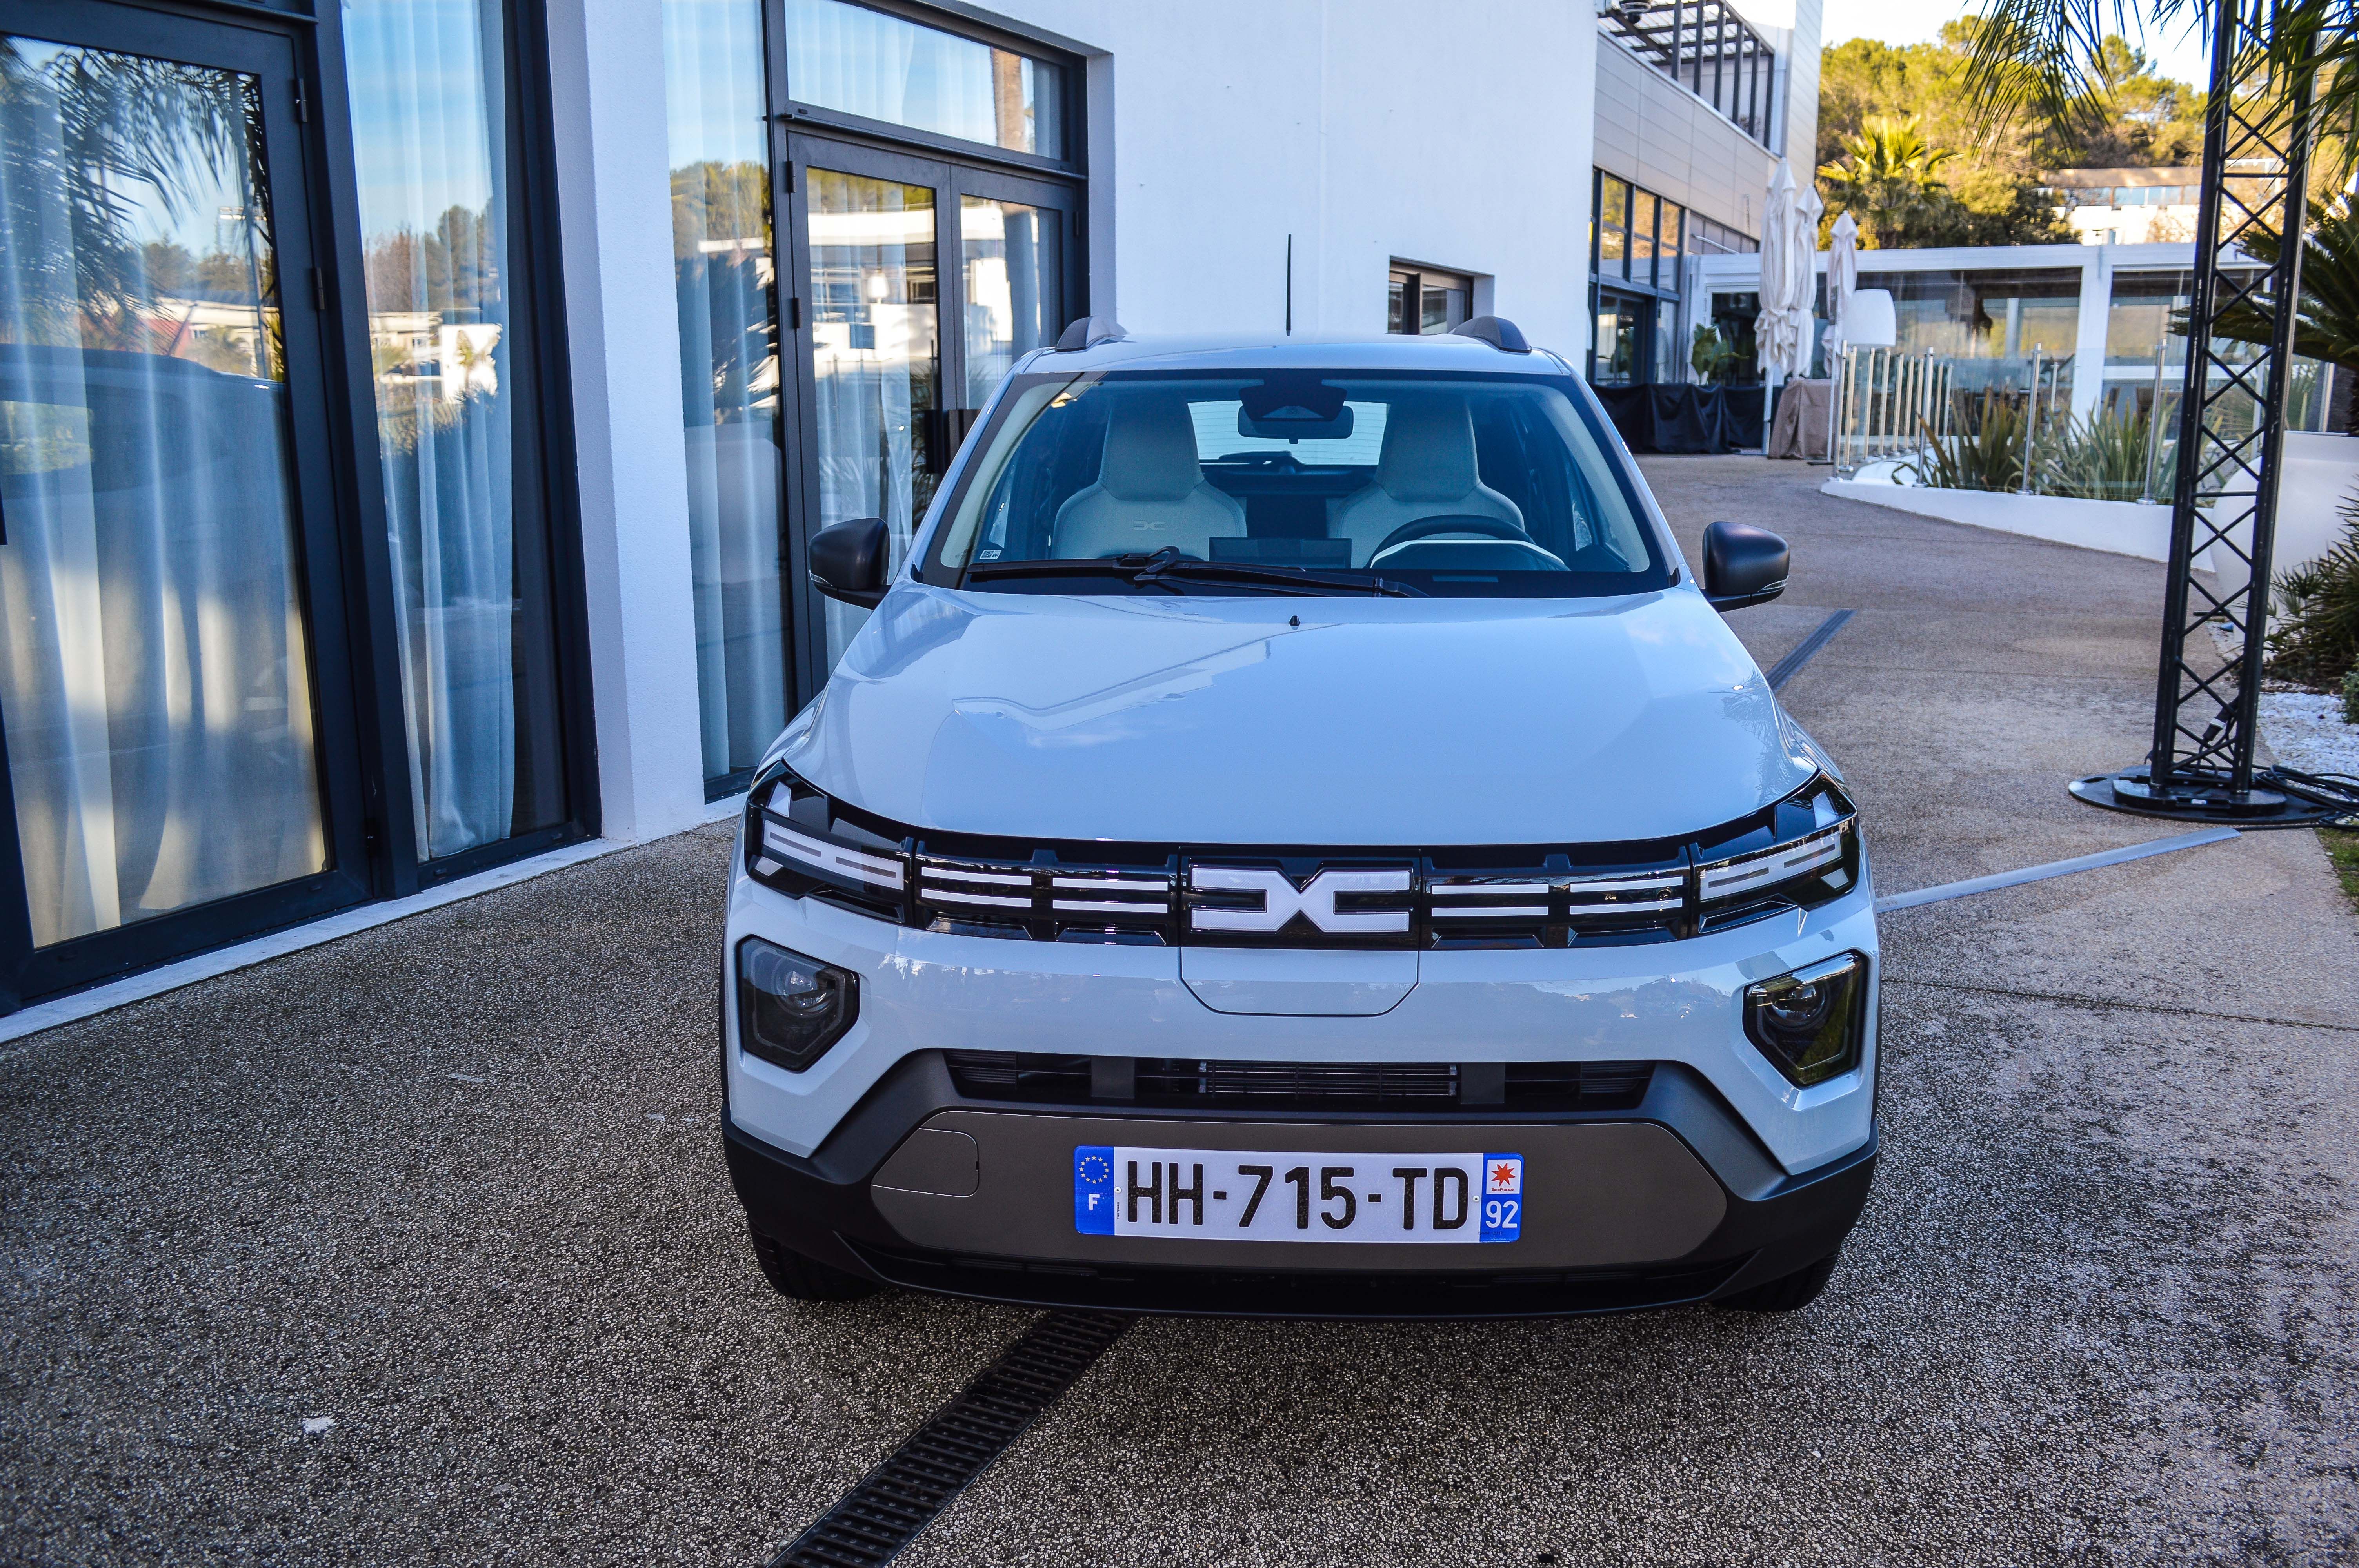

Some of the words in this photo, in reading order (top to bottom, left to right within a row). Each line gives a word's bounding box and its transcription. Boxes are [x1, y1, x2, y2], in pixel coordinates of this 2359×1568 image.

[1089, 1194, 1100, 1210] F
[1127, 1160, 1469, 1230] HH-715-TD
[1486, 1200, 1518, 1228] 92
